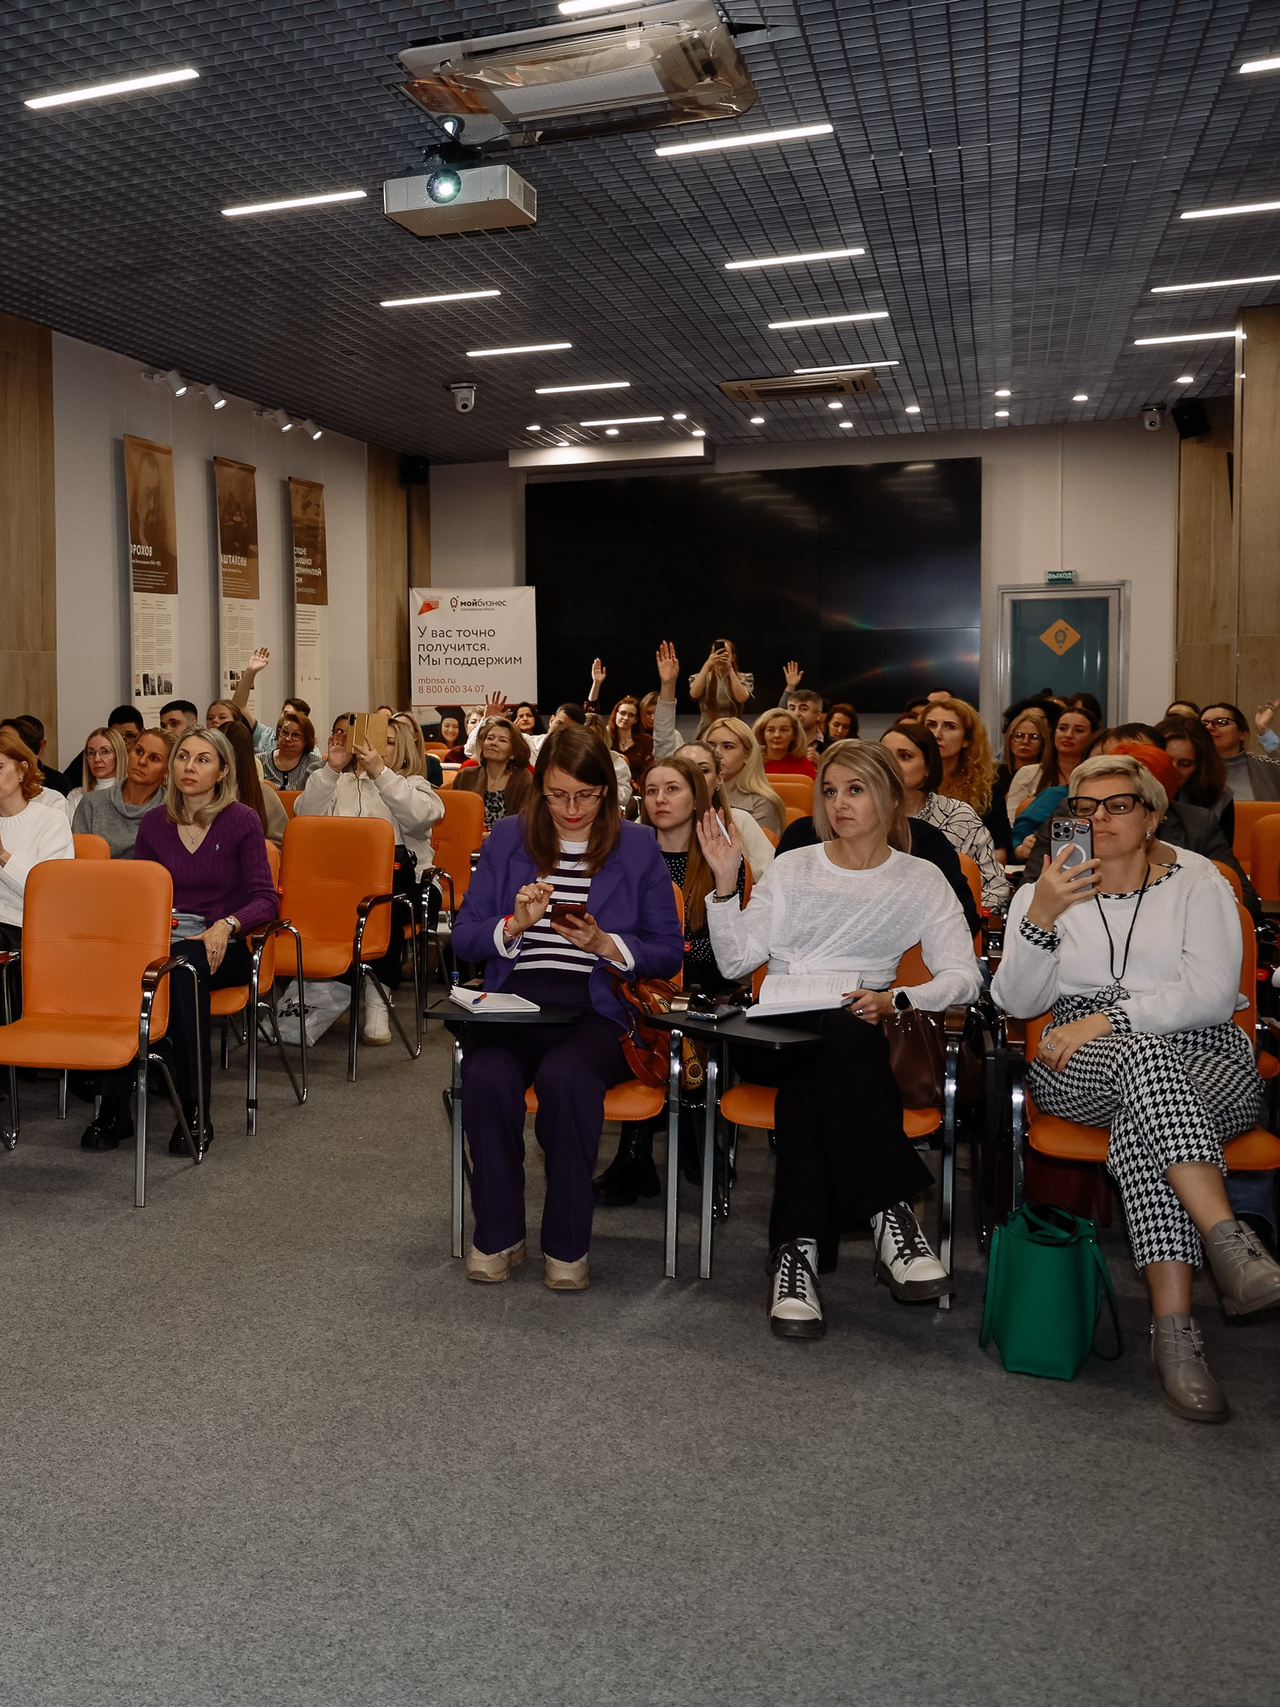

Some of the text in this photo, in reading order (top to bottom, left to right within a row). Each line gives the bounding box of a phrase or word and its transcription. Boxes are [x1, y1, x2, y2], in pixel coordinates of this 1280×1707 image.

[417, 626, 496, 638] У вас точно
[417, 643, 490, 654] получится.
[418, 654, 522, 668] Мы поддержим
[425, 685, 442, 693] 800
[444, 685, 460, 693] 600
